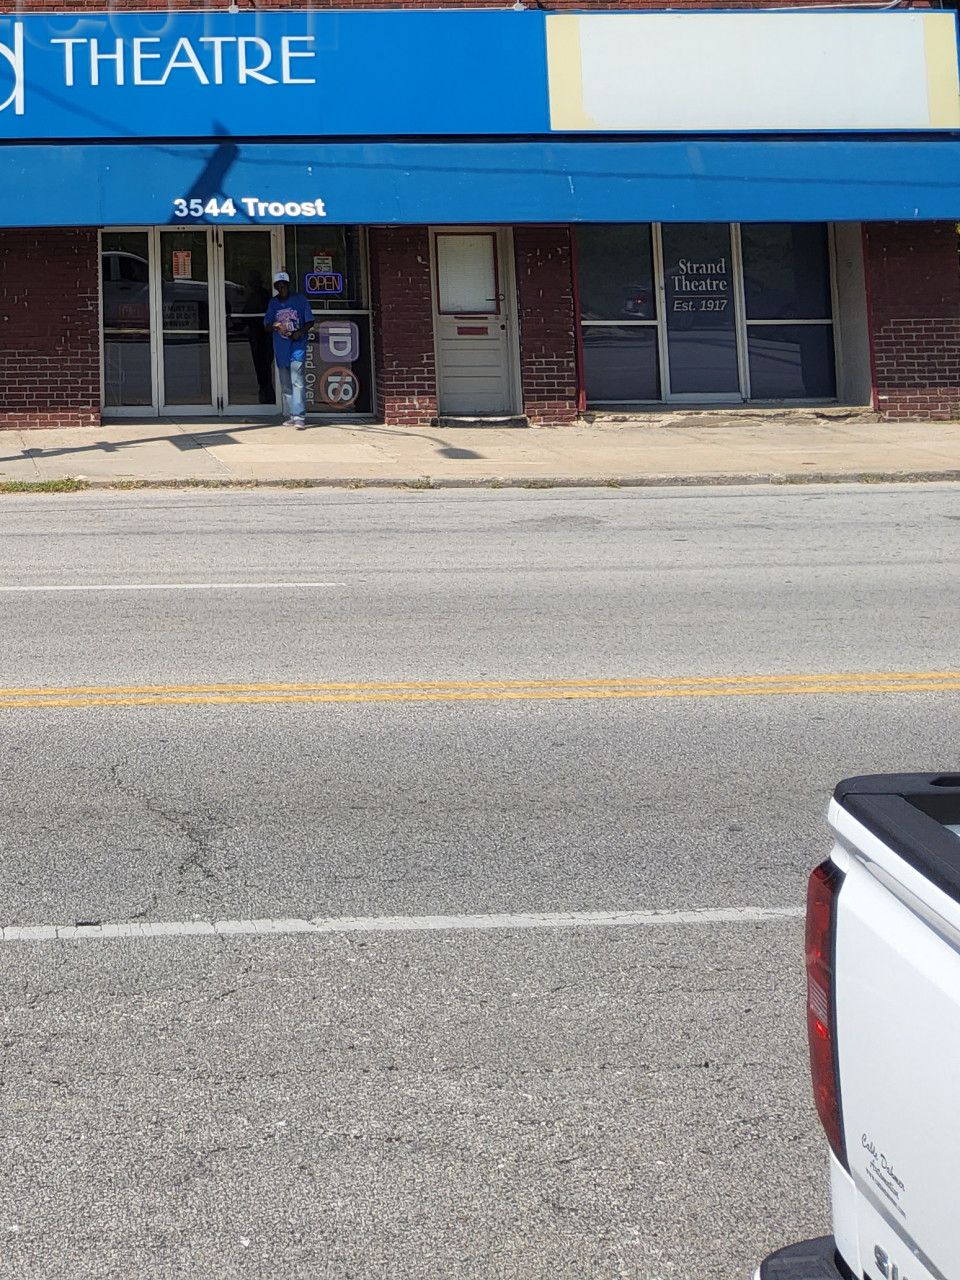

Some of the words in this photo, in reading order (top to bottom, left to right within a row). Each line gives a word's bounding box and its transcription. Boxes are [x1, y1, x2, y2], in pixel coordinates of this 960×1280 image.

[51, 35, 317, 87] THEATRE
[173, 198, 237, 217] 3544
[241, 198, 327, 217] Troost
[679, 258, 726, 274] Strand
[308, 275, 340, 291] OPEN
[671, 276, 728, 291] Theatre
[673, 300, 696, 311] Est.
[700, 300, 728, 311] 1917
[328, 327, 352, 357] ID
[305, 345, 316, 369] and
[305, 373, 317, 405] Over
[327, 375, 353, 402] 18
